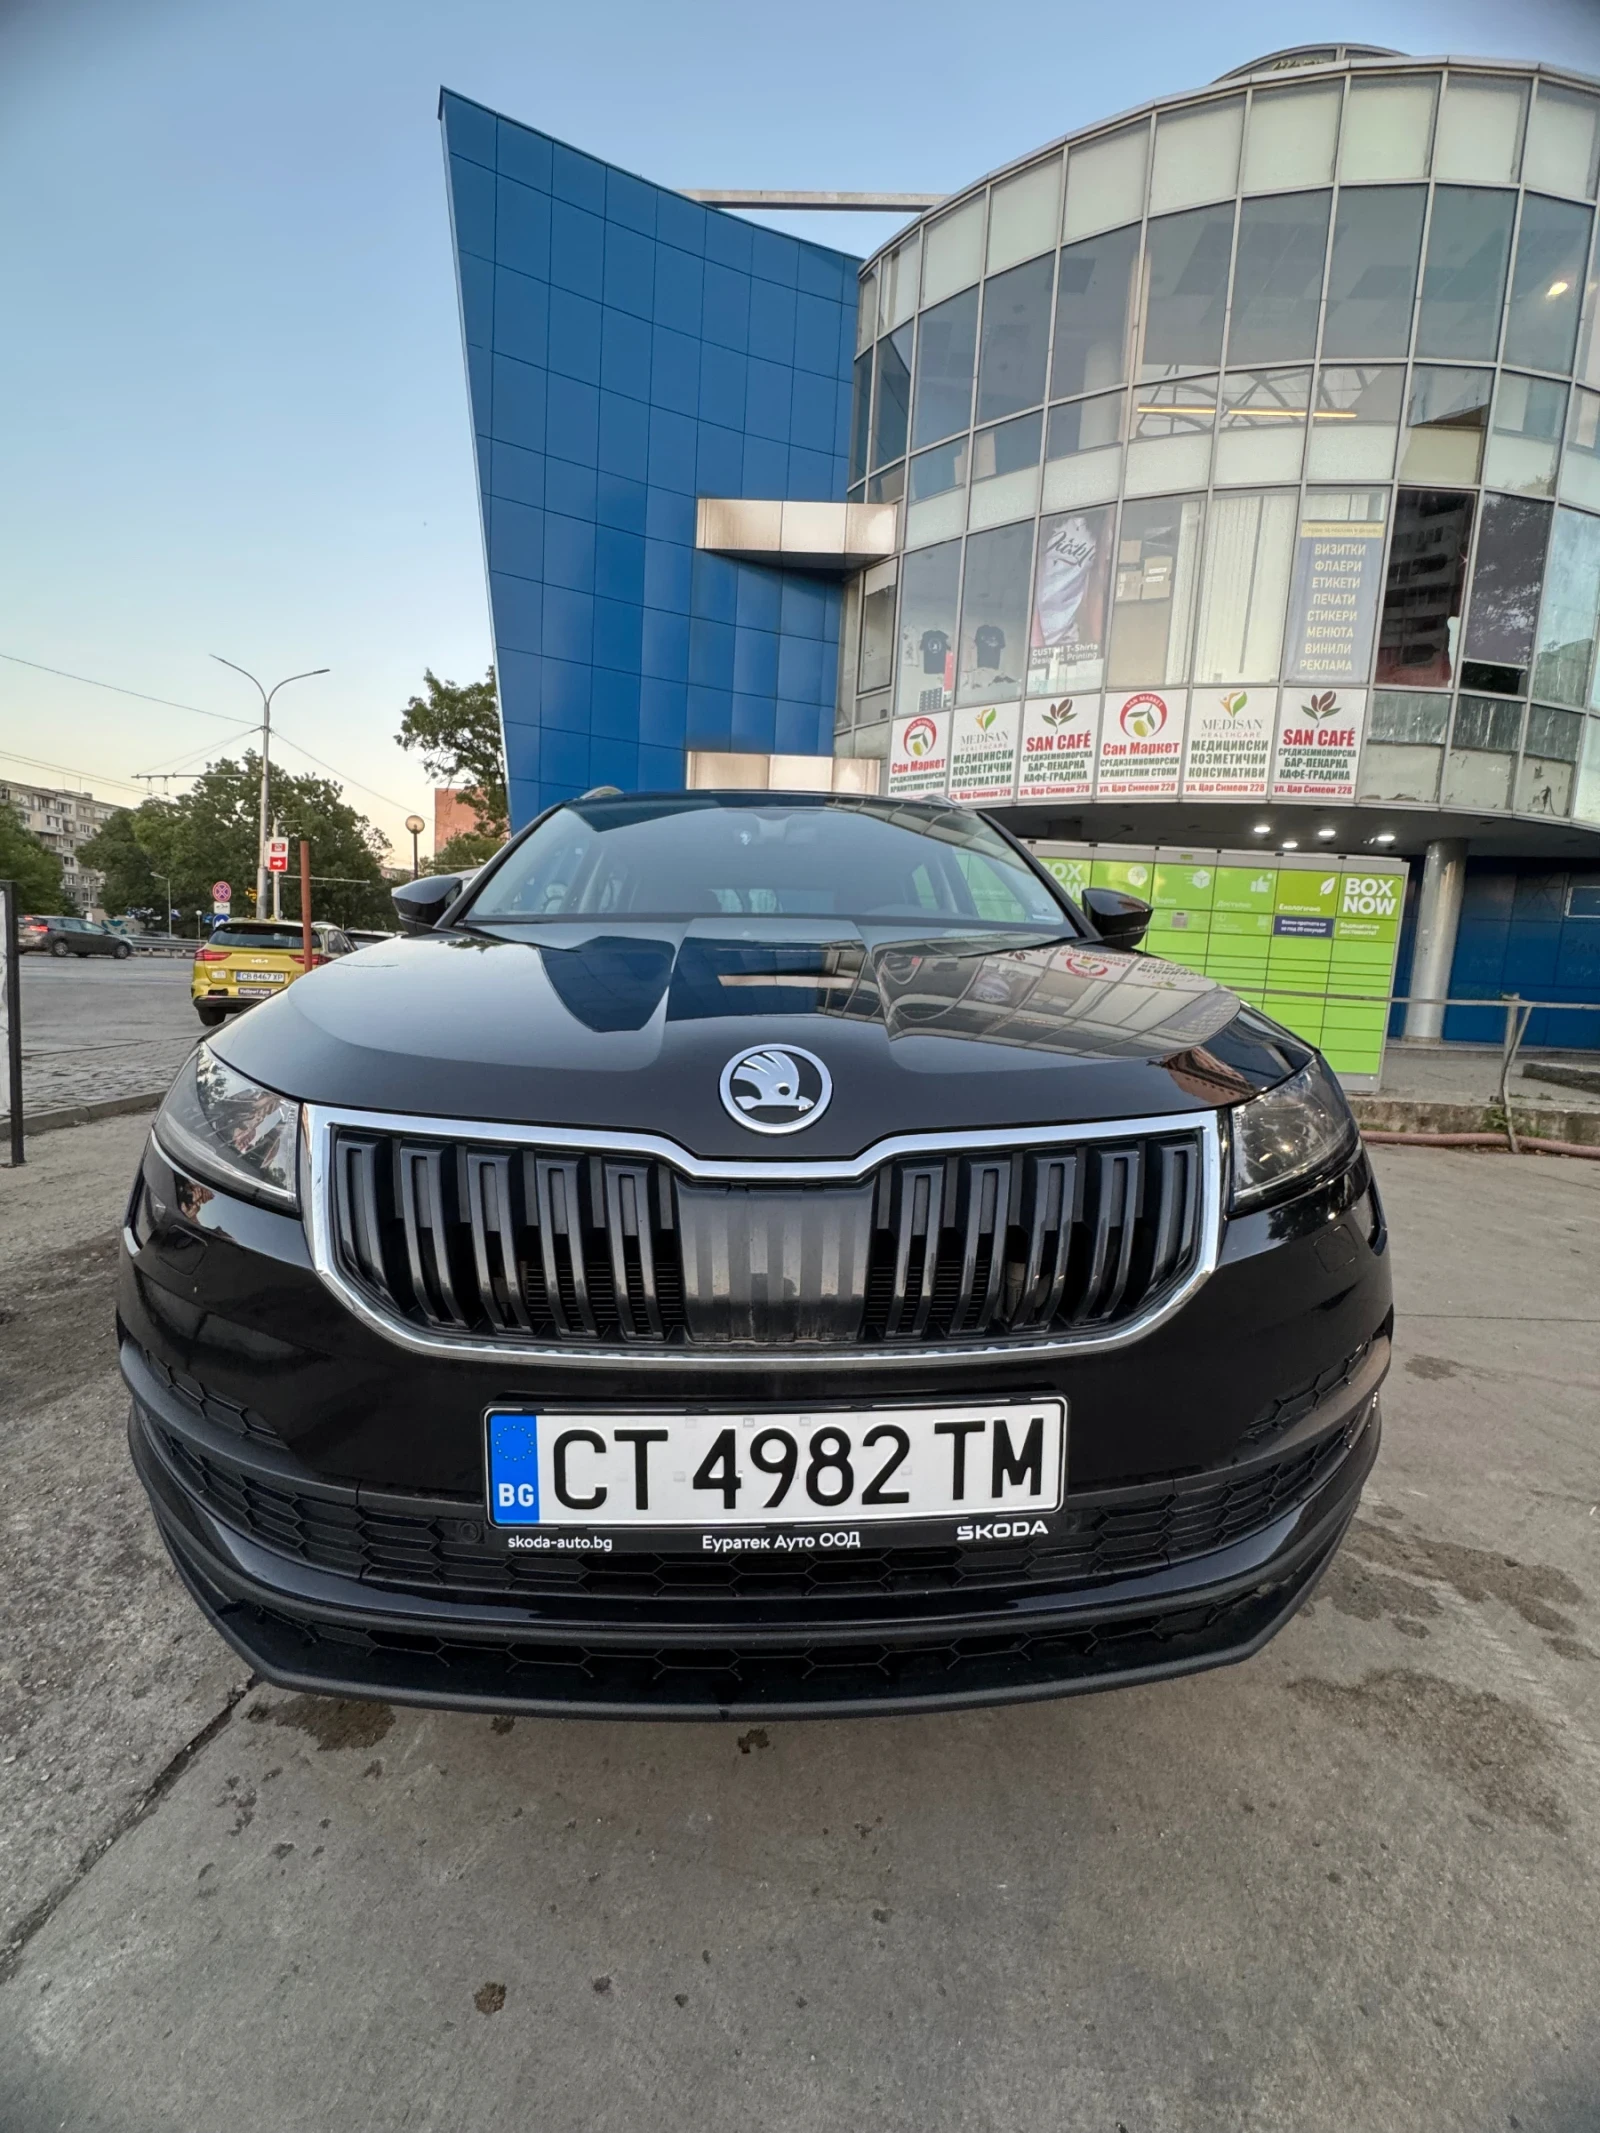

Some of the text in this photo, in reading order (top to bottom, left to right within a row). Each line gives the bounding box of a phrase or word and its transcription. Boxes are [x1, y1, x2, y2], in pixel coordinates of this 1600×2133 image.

[1314, 543, 1366, 556] ВИЗИТКИ
[1315, 560, 1362, 572] ФЛАЕРИ
[1312, 577, 1361, 589] ЕТИКЕТИ
[1312, 594, 1356, 605] ПЕЧАТИ
[1307, 610, 1358, 622] СТИКЕРИ
[1306, 627, 1354, 638] МЕНЮТА
[1032, 643, 1099, 657] CUSTM T-Shirts
[1304, 643, 1352, 654] ВИНИЛИ
[1300, 659, 1352, 671] РЕКЛАМА
[1201, 718, 1264, 730] MEDISAN
[961, 731, 1009, 745] MEDISAN
[1026, 730, 1092, 752] SAN CAFÉ
[1283, 728, 1356, 747] SAN CAFÉ
[1103, 742, 1180, 756] Сан Маркет
[1191, 740, 1269, 752] МЕДИЦИНСКИ
[953, 749, 1014, 765] МЕДИЦИНСКИ
[1190, 753, 1266, 765] КОЗМЕТИЧНИ
[1284, 758, 1348, 768] БАР-ПЕКАРНА
[892, 759, 945, 774] Сан Маркет
[953, 762, 1012, 776] КОЗМЕТИЧНИ
[1028, 760, 1085, 772] БАР-ПЕКАРНА
[1024, 770, 1088, 783] КАФЕ-ГРАДИНА
[1188, 767, 1265, 778] КОНСУМАТИВИ
[1279, 769, 1350, 780] КАФЕ-ГРАДИНА
[951, 774, 1012, 788] КОНСУМАТИВИ
[1031, 786, 1044, 796] Цар
[1112, 784, 1126, 792] Цар
[1199, 783, 1214, 793] Цар
[1216, 783, 1248, 793] Симеон
[1250, 783, 1265, 793] 228
[1287, 785, 1302, 794] Цар
[1304, 785, 1336, 794] Симеон
[1337, 785, 1353, 795] 228
[1345, 878, 1395, 897] BOX
[1343, 896, 1397, 915] NOW
[552, 1417, 1045, 1511] CT 4982 TM
[498, 1482, 535, 1508] BG
[507, 1535, 613, 1552] skoda-auto.bg
[702, 1531, 861, 1552] Еуратек Ауто ООД
